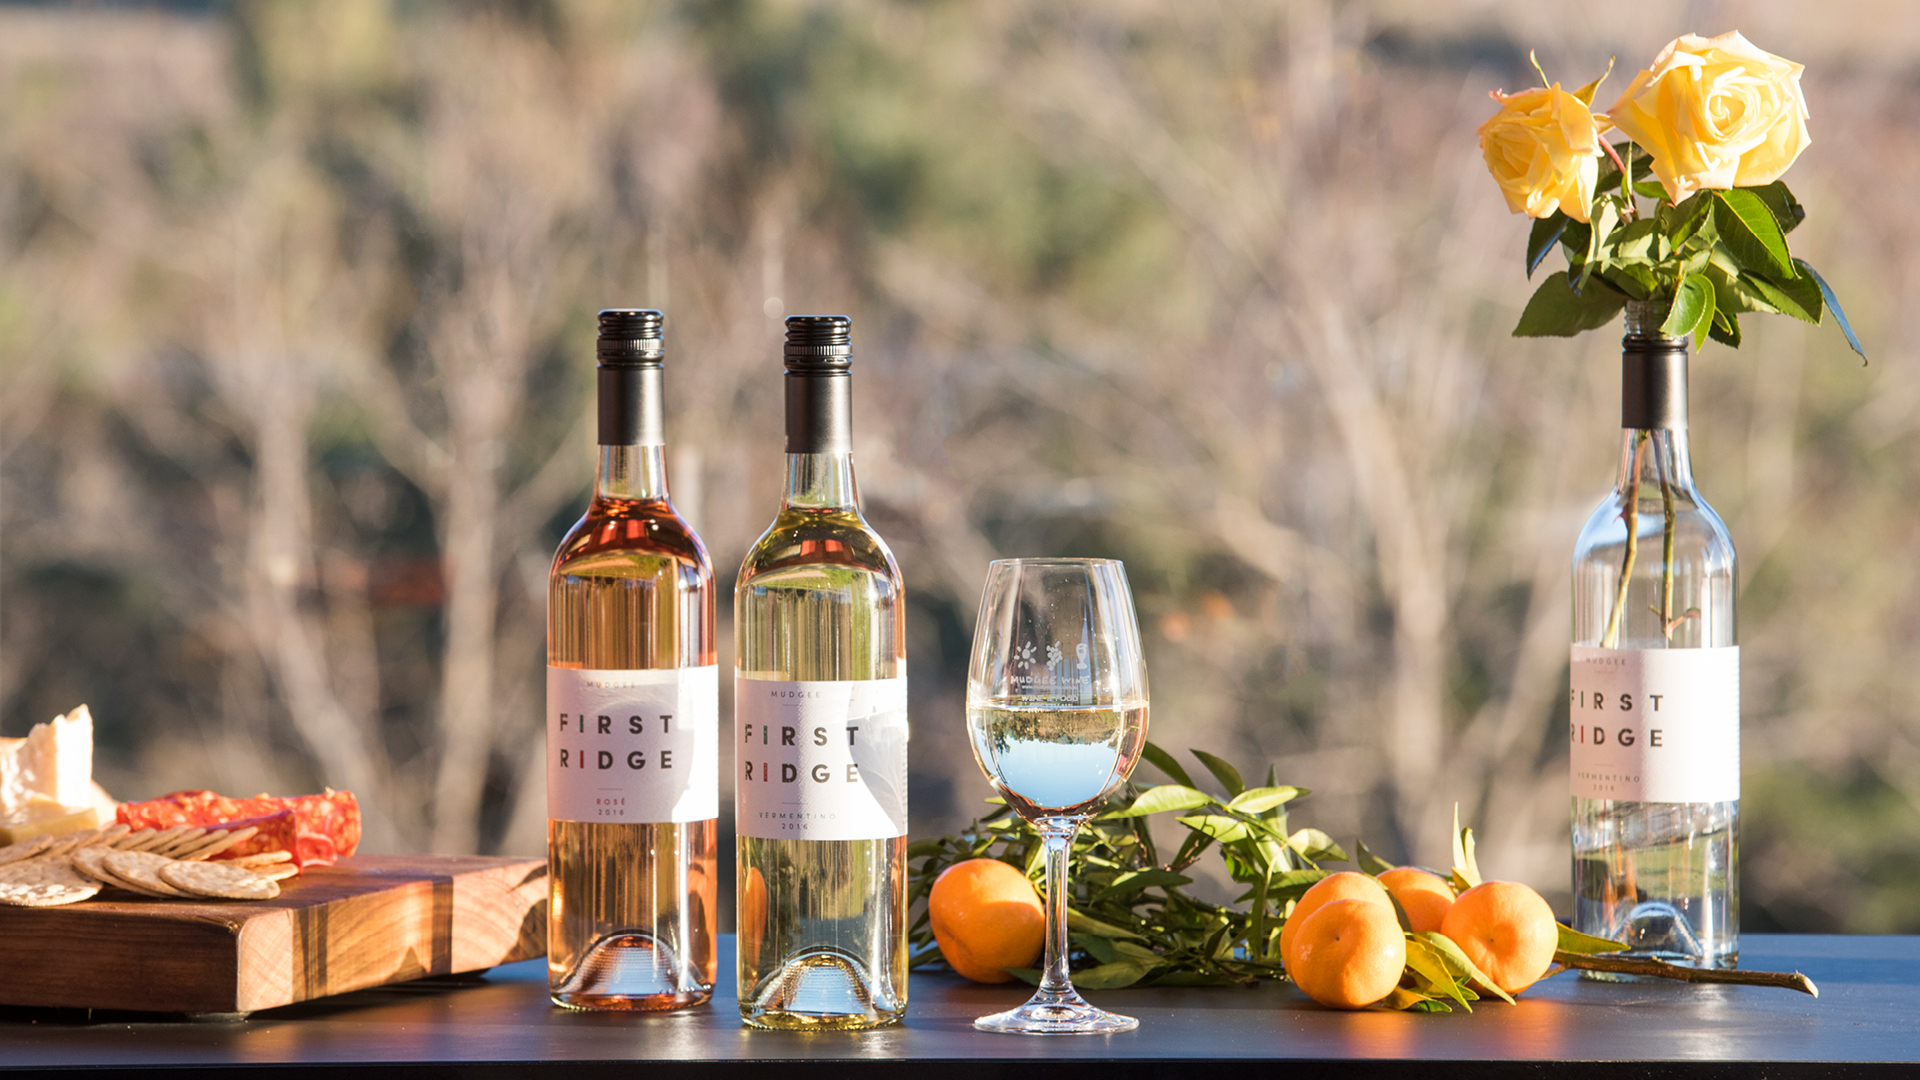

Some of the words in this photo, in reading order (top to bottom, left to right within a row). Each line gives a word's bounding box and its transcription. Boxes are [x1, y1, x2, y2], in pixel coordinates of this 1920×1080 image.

[587, 681, 636, 689] MUDGEE
[1010, 675, 1057, 685] MUDGEE
[1061, 675, 1090, 685] WINE
[560, 713, 673, 734] FIRST
[745, 723, 859, 746] FIRST
[560, 749, 672, 770] RIDGE
[745, 761, 858, 783] RIDGE
[596, 797, 625, 805] ROSÉ
